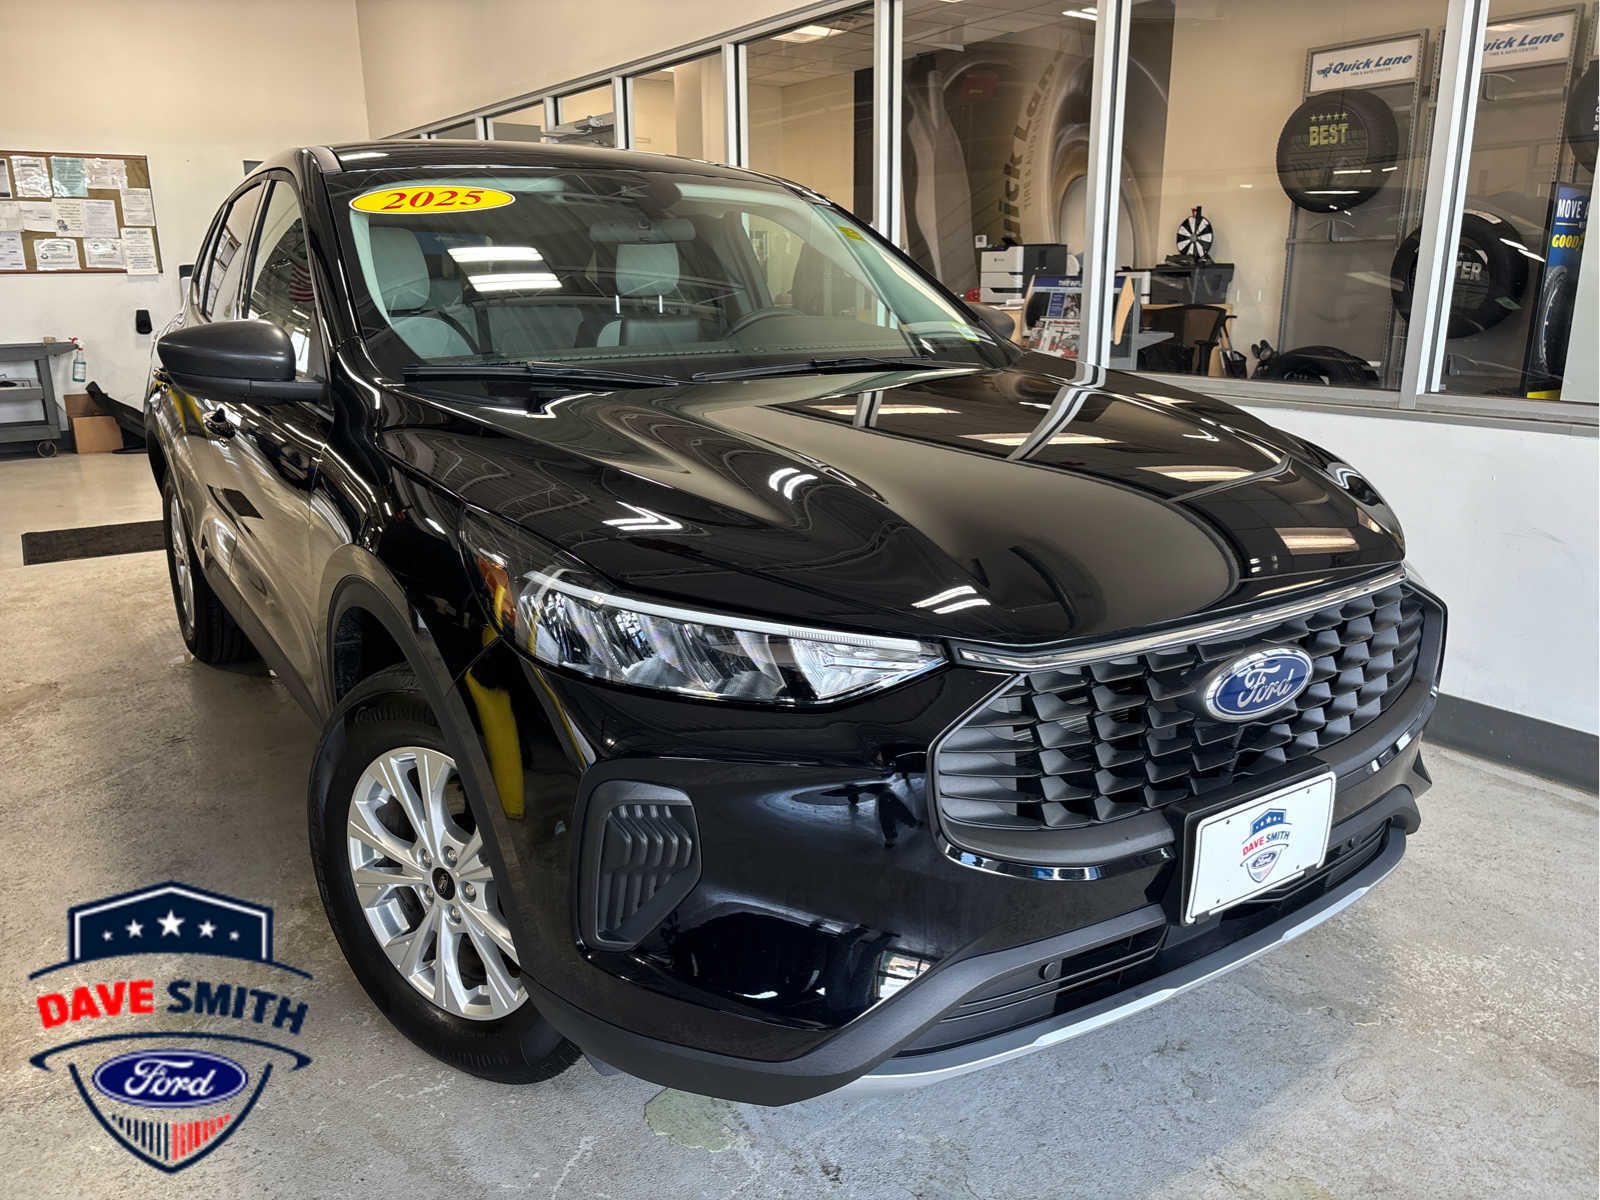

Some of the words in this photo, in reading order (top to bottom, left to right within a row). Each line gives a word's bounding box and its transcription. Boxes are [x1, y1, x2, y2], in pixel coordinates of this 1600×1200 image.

[1484, 36, 1517, 51] uick
[1518, 33, 1564, 47] Lane
[1333, 58, 1373, 74] Quick
[1374, 55, 1412, 68] Lane
[1309, 123, 1349, 147] BEST
[381, 190, 484, 210] 2025
[999, 151, 1023, 245] uick
[1557, 199, 1582, 218] MOVE
[1238, 665, 1294, 707] Ford
[1242, 836, 1264, 856] DAVE
[1266, 830, 1291, 843] SMITH
